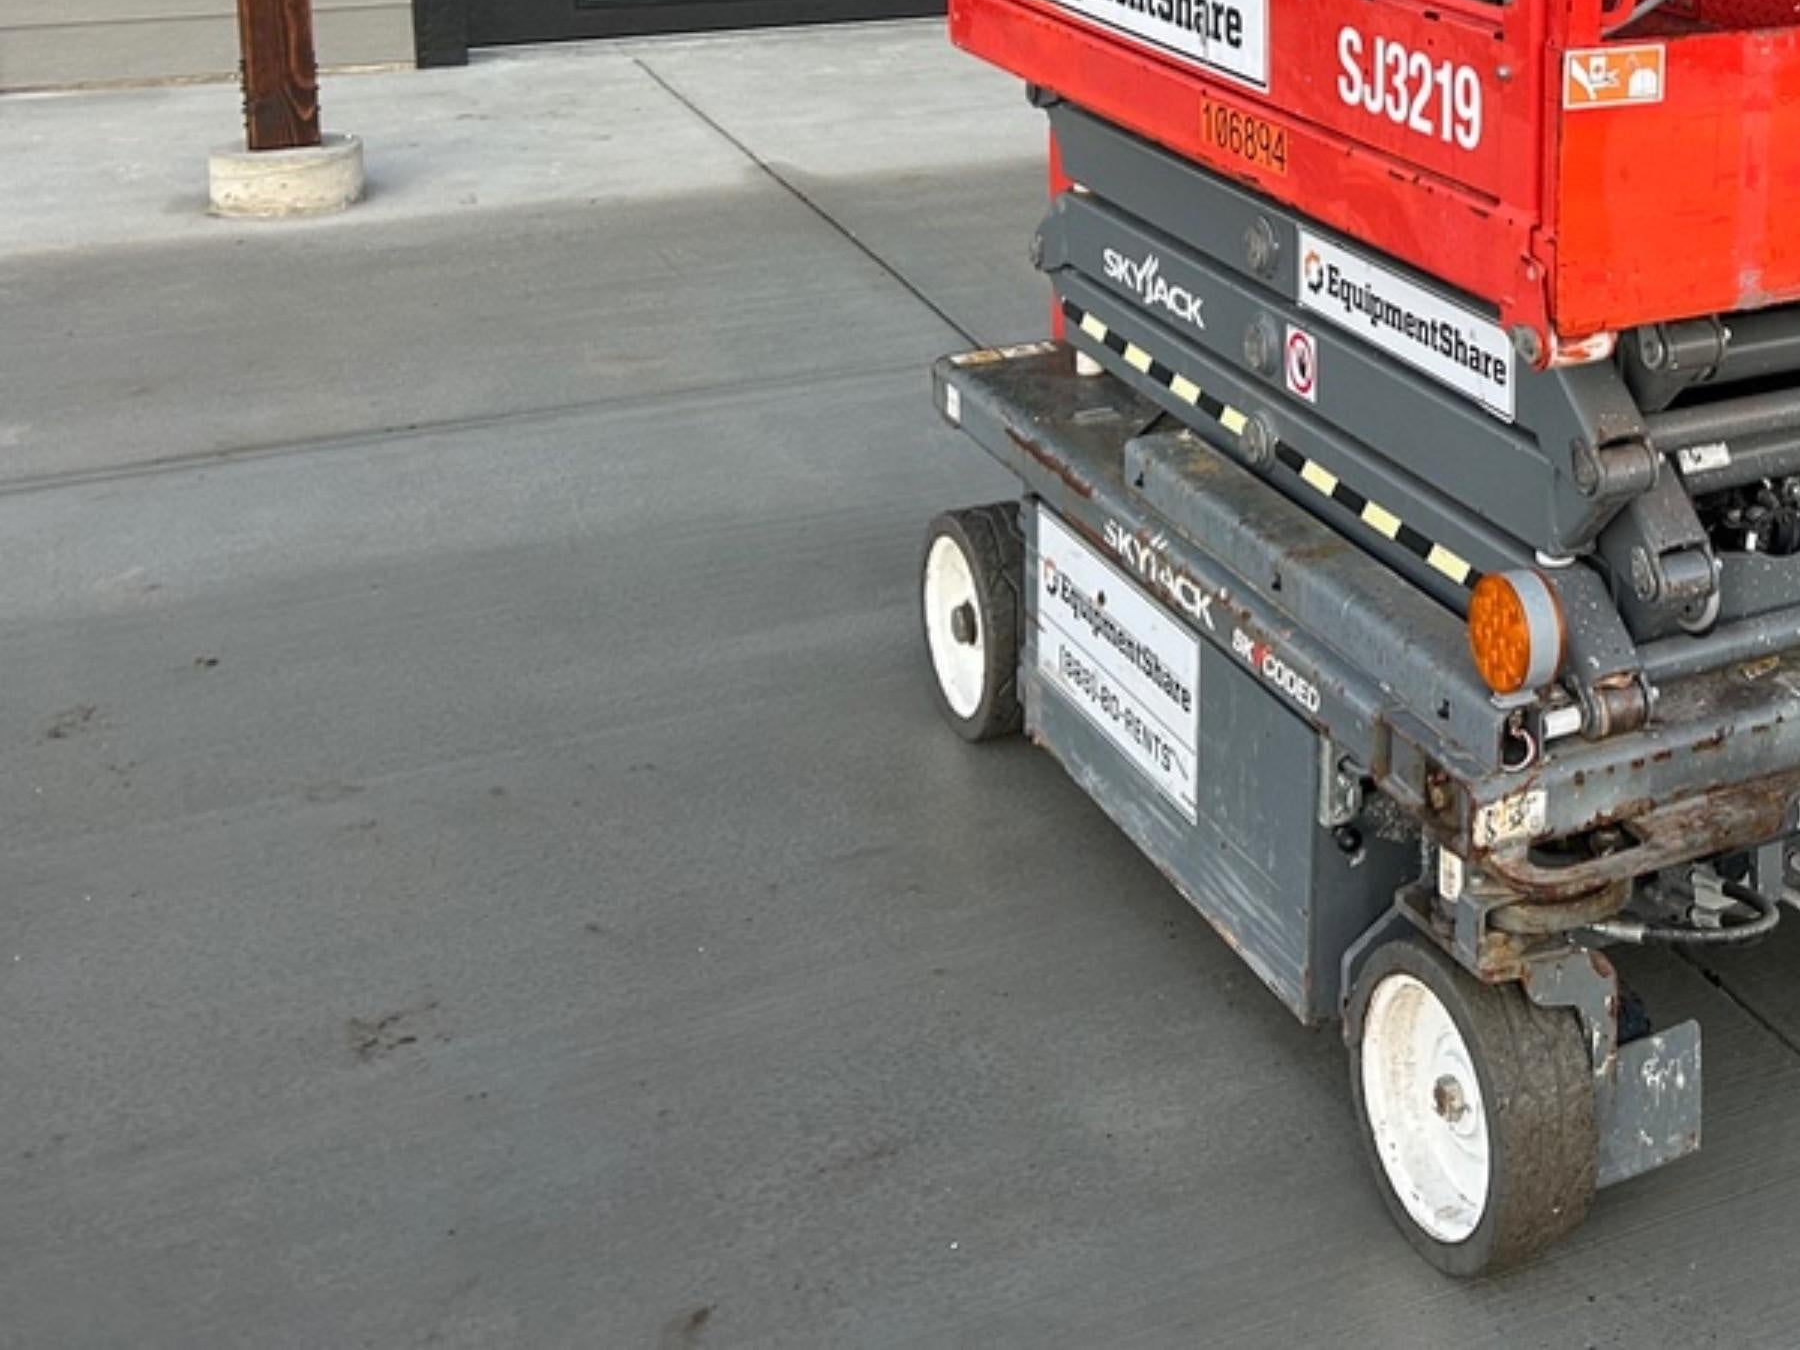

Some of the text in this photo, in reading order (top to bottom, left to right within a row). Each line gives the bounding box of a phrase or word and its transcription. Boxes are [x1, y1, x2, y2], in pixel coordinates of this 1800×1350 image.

[1202, 104, 1287, 172] 106894
[1337, 25, 1483, 151] SJ3219
[1102, 248, 1206, 330] SKYJACK
[1326, 263, 1508, 387] EquipmentShare
